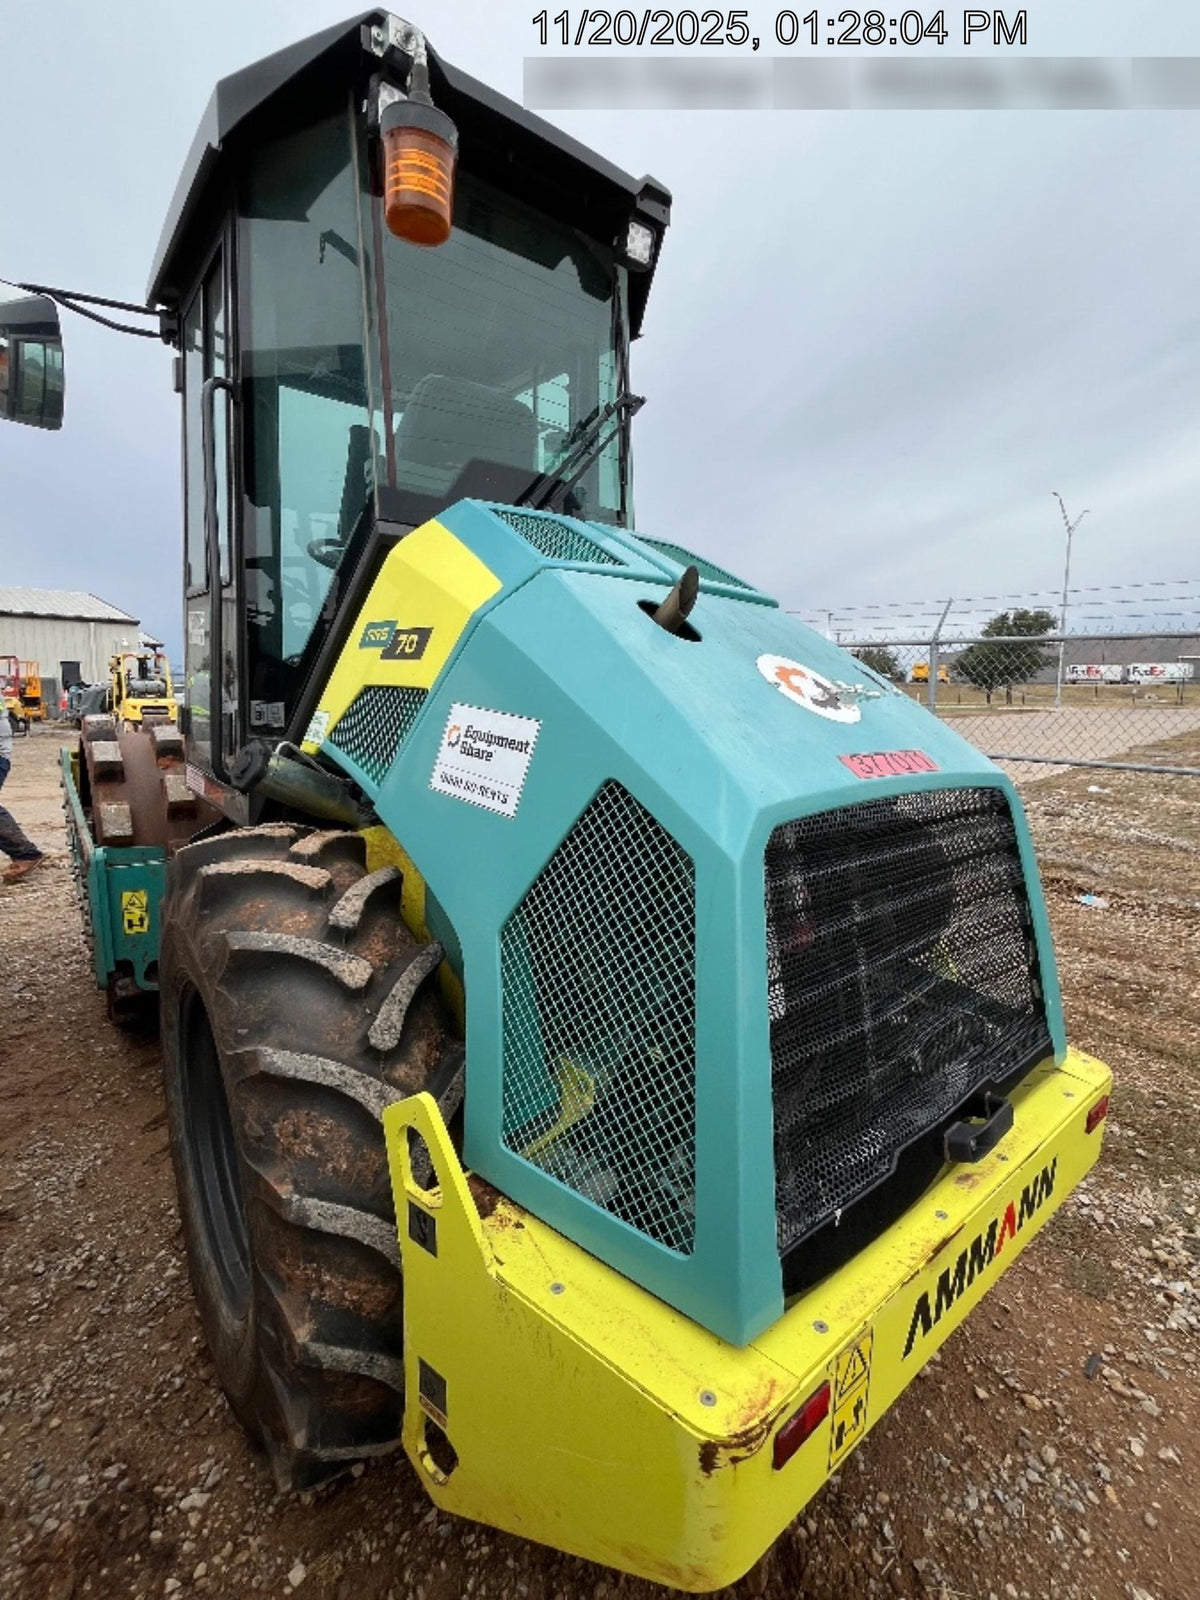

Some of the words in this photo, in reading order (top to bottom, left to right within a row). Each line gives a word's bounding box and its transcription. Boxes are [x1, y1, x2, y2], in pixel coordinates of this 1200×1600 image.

[394, 634, 419, 655] 70
[459, 741, 494, 762] Share
[464, 725, 531, 755] Equipment
[901, 1155, 1057, 1361] AMMANN
